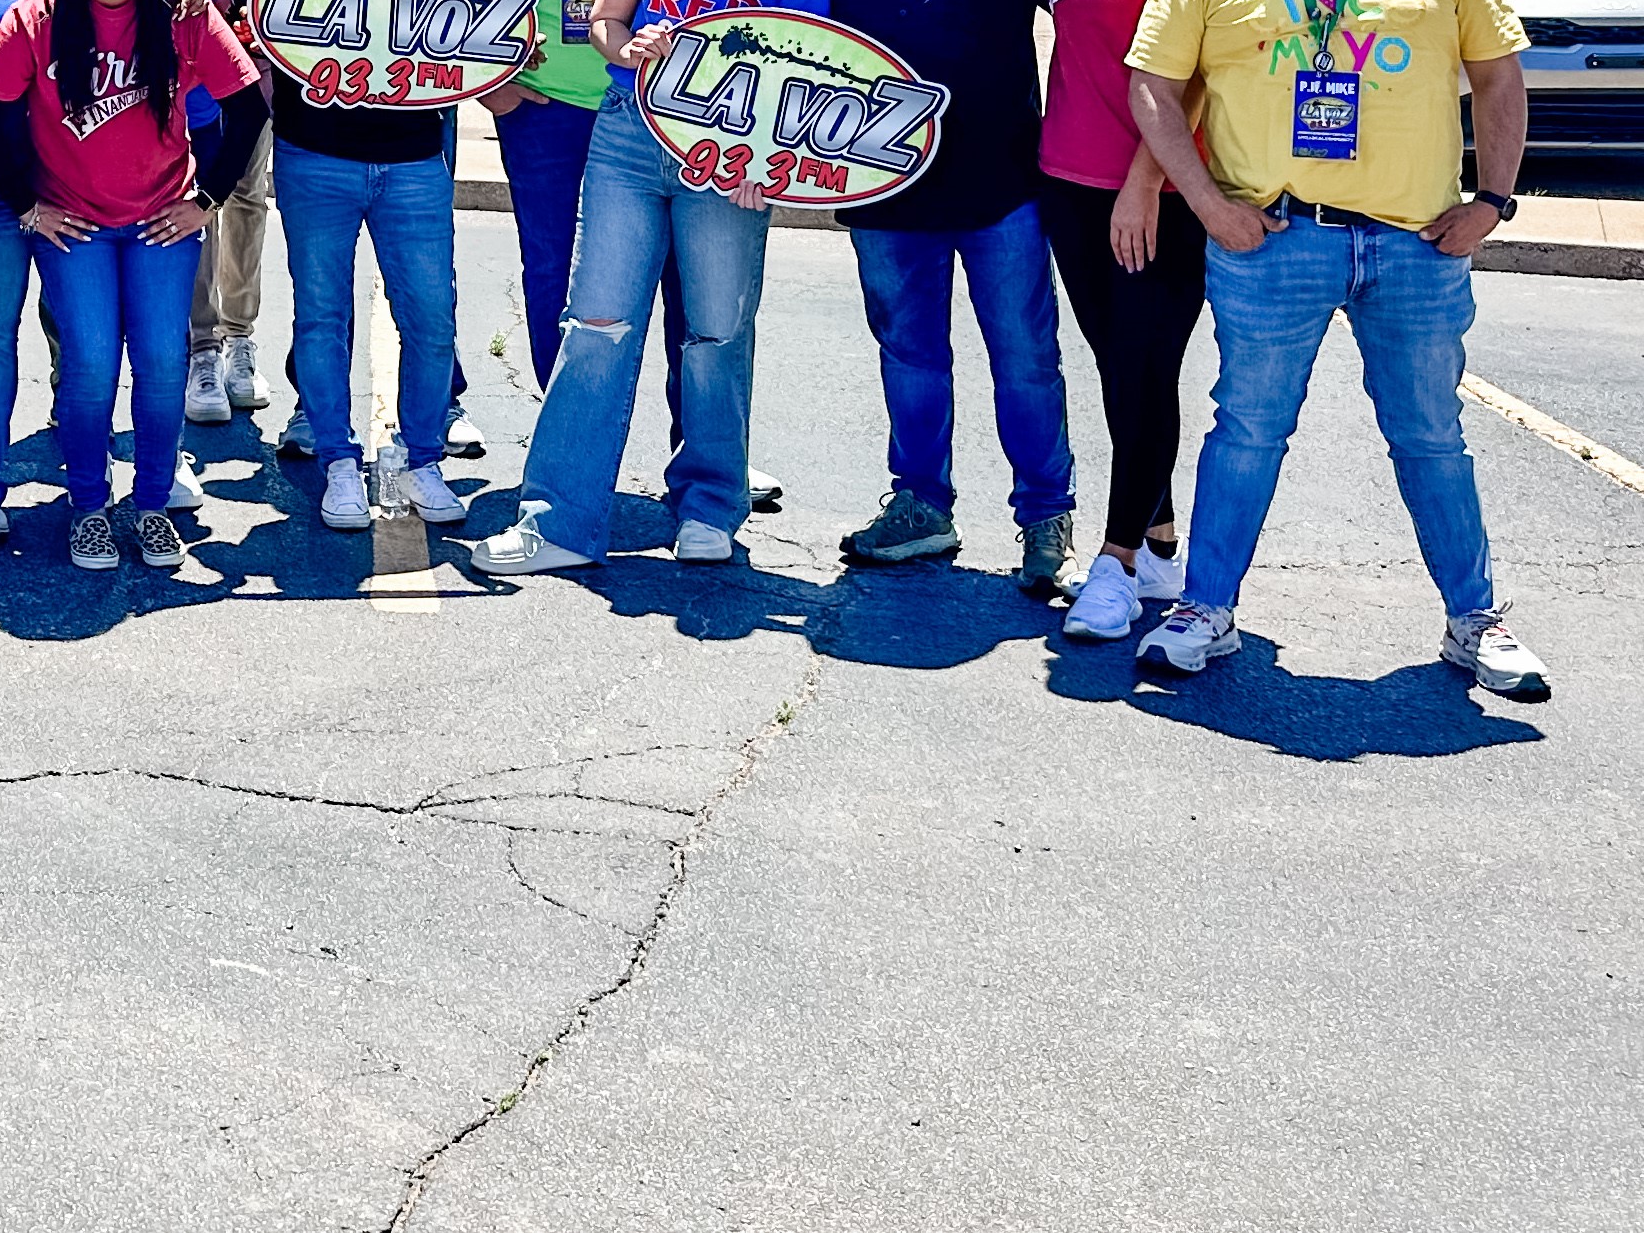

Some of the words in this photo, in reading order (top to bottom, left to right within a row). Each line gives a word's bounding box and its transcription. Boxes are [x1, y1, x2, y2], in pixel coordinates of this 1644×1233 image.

[1269, 30, 1411, 76] MYO
[306, 57, 415, 105] 93.3
[416, 61, 464, 92] FM
[647, 30, 756, 135] LA
[774, 77, 946, 172] VOZ
[1325, 81, 1356, 96] MIKE
[681, 138, 797, 197] 933
[796, 156, 849, 194] FM
